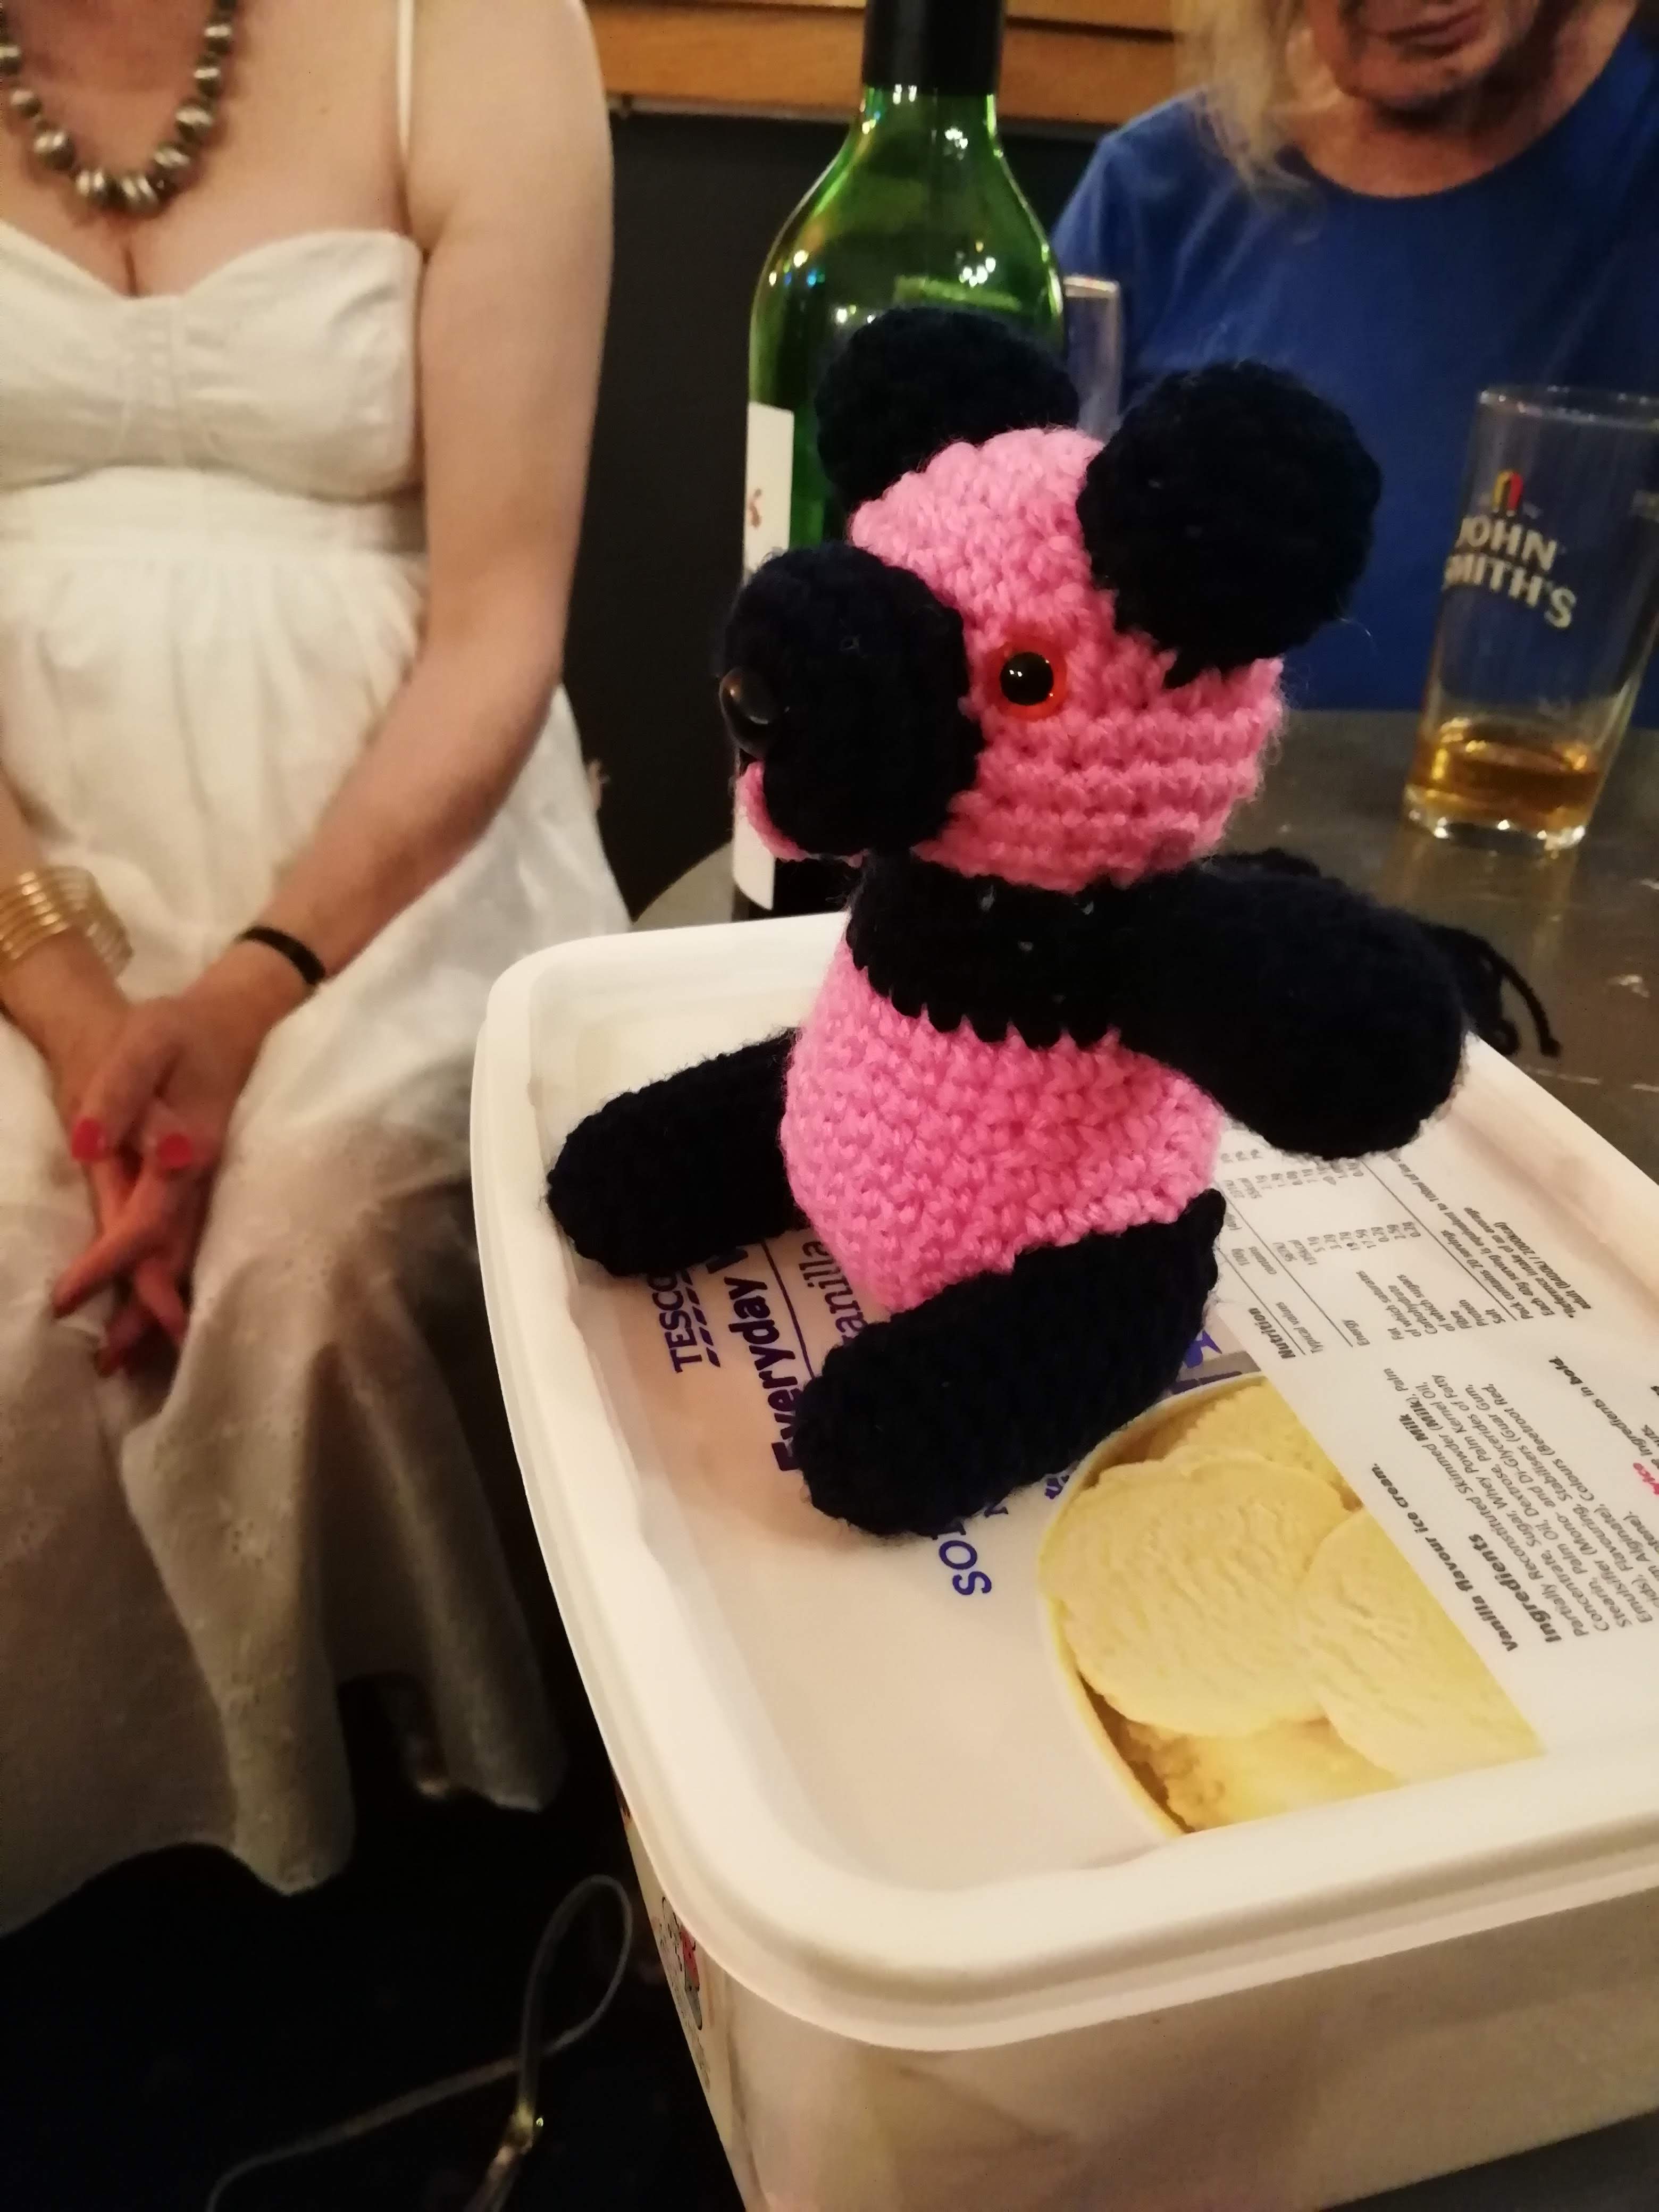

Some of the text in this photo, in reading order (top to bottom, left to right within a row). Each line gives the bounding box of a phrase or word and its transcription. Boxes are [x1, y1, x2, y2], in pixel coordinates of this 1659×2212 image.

[1437, 1203, 1449, 1211] to
[1463, 1207, 1496, 1234] average
[1443, 1212, 1485, 1247] equivalent
[1491, 1235, 1506, 1244] an
[1493, 1222, 1536, 1255] 2000kcal)
[1497, 1245, 1514, 1253] of
[1440, 1229, 1534, 1319] Pack contains 20 servings
[1488, 1254, 1520, 1281] serving
[1511, 1254, 1539, 1277] intake
[799, 1240, 866, 1348] anilla
[1396, 1274, 1425, 1298] sugars
[1565, 1290, 1591, 1310] adult
[1355, 1270, 1422, 1337] of which saturates
[1388, 1285, 1438, 1335] Carbohydrate
[1418, 1299, 1446, 1322] which
[1459, 1299, 1489, 1327] Protein
[1485, 1309, 1506, 1324] Salt
[1530, 1297, 1555, 1316] Each
[1248, 1308, 1296, 1359] Nutrition
[1275, 1301, 1323, 1354] Typical values
[1342, 1320, 1370, 1346] Energy
[1387, 1327, 1404, 1340] Fat
[1450, 1310, 1472, 1329] Fibre
[1415, 1382, 1436, 1399] Oil,
[1465, 1384, 1490, 1411] Gum,
[1580, 1386, 1595, 1397] in
[1429, 1401, 1468, 1434] Kernel
[1487, 1414, 1521, 1443] (Guar
[1464, 1436, 1492, 1462] Palm
[1481, 1384, 1651, 1562] Alginate), Colours (Beetroot Red,
[1516, 1445, 1573, 1502] Stabilisers
[1383, 1368, 1610, 1632] Concentrate, Sugar, Whey Powder (Milk), Palm
[1431, 1375, 1653, 1623] Emulsifier (Mono- and Di-Glycerides of Fatty
[1490, 1463, 1540, 1517] Dextrose,
[1398, 1413, 1590, 1637] Partially Reconstituted Skimmed Milk
[1534, 1519, 1559, 1540] Oil,
[1572, 1503, 1634, 1572] Flavouring,
[1371, 1463, 1519, 1652] Vanilla flavour ice cream.
[1556, 1543, 1588, 1575] Palm
[1468, 1534, 1562, 1643] Ingredients
